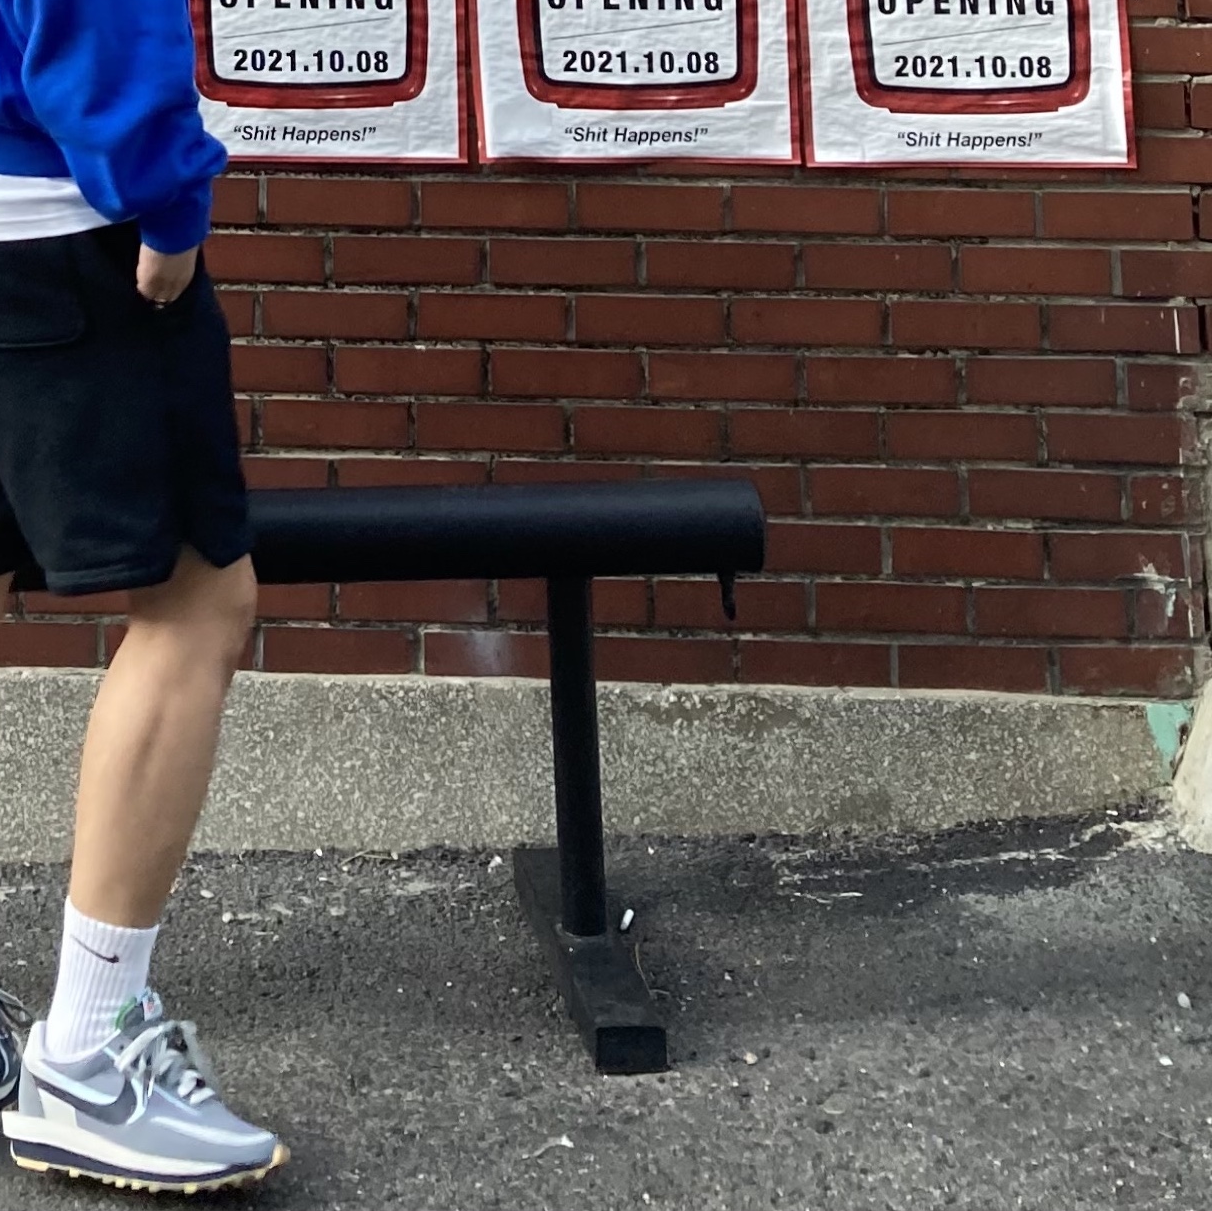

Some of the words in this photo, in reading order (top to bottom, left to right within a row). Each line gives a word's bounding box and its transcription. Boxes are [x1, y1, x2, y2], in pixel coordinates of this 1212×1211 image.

[234, 50, 388, 72] 2021.10.08
[563, 50, 719, 73] 2021.10.08
[895, 56, 1051, 78] 2021.10.08
[234, 126, 276, 140] “Shit
[282, 126, 376, 144] Happens!”
[565, 127, 608, 141] “Shit
[615, 128, 707, 145] Happens!”
[898, 132, 941, 146] “Shit
[948, 132, 1042, 150] Happens!”
